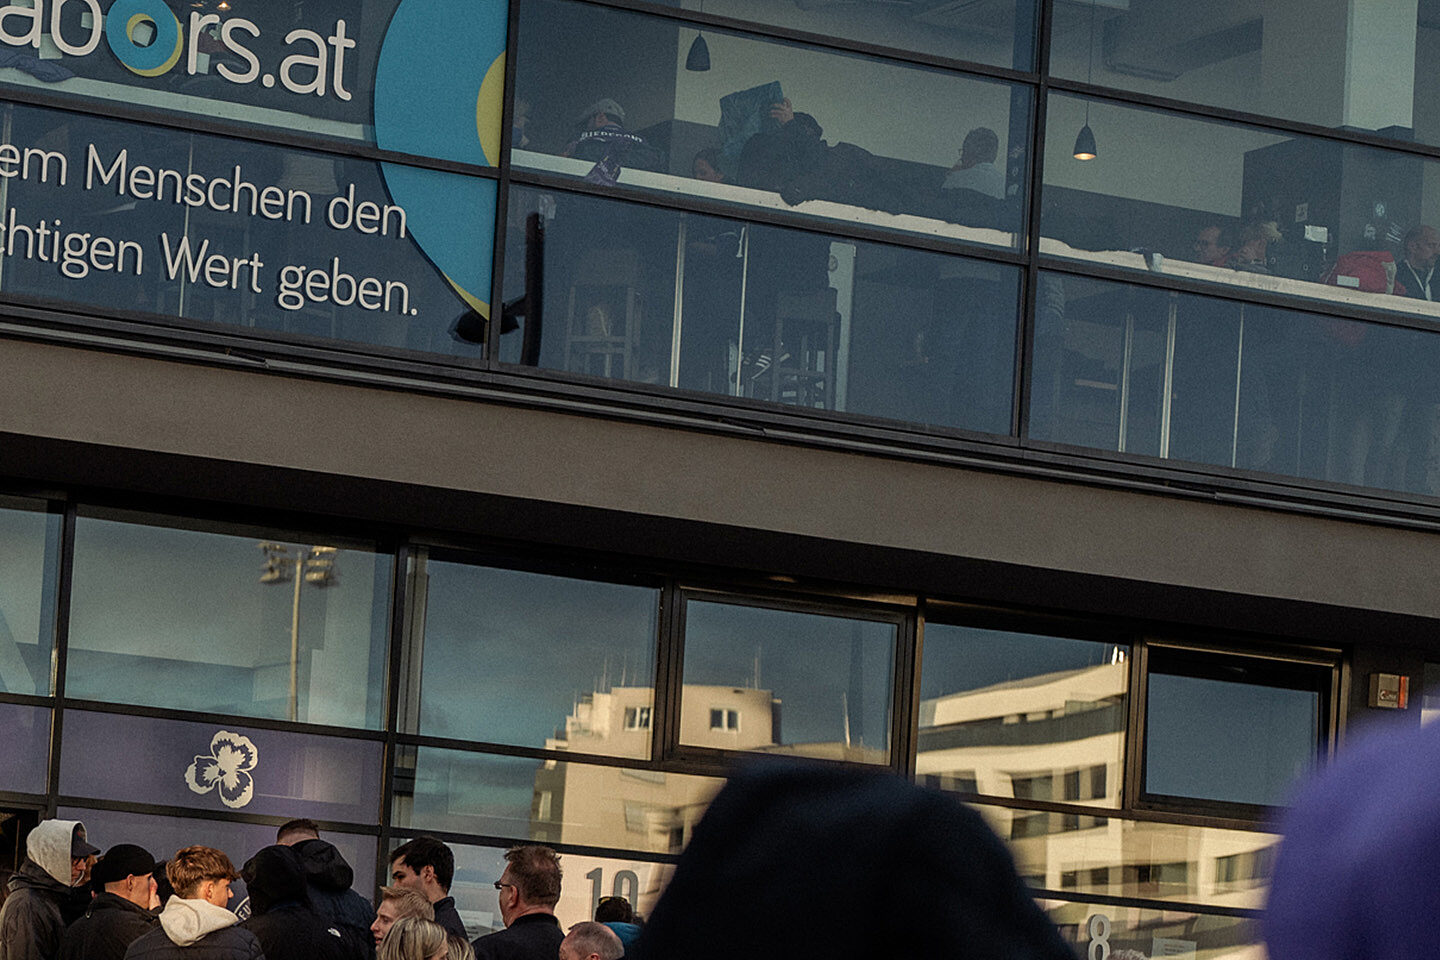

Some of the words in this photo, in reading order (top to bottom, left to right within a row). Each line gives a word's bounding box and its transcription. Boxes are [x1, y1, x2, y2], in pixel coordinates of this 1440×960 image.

[86, 143, 312, 225] Menschen
[327, 182, 408, 239] den
[161, 232, 265, 294] Wert
[277, 256, 419, 317] geben.
